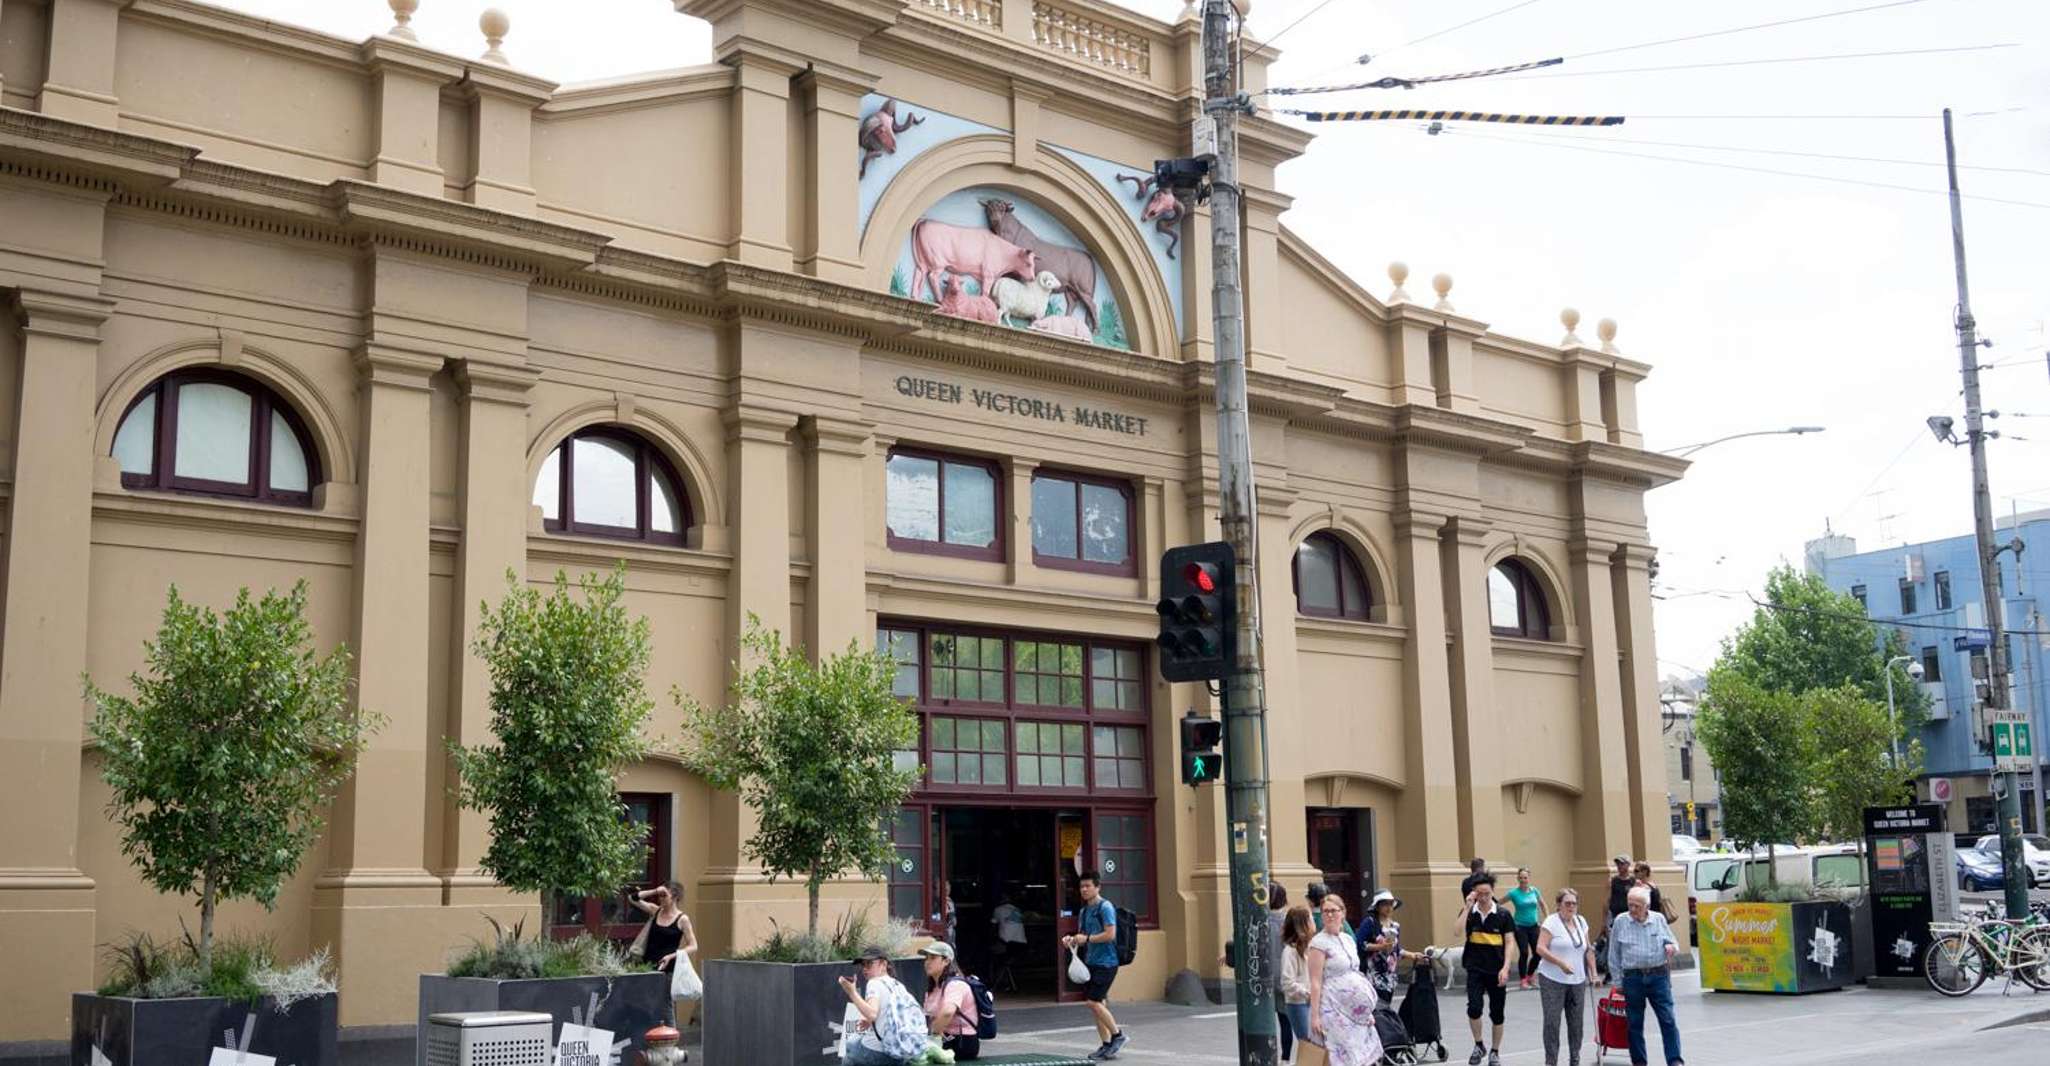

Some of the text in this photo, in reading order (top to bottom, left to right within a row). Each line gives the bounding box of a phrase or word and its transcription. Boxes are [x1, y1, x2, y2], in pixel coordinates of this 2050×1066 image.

[896, 376, 1148, 436] QUEEN VICTORIA MARKET
[1932, 843, 1946, 912] ELIZABETH ST
[1711, 906, 1777, 944] Summer
[560, 1054, 600, 1066] VICTORIA
[561, 1041, 589, 1057] QUEEN
